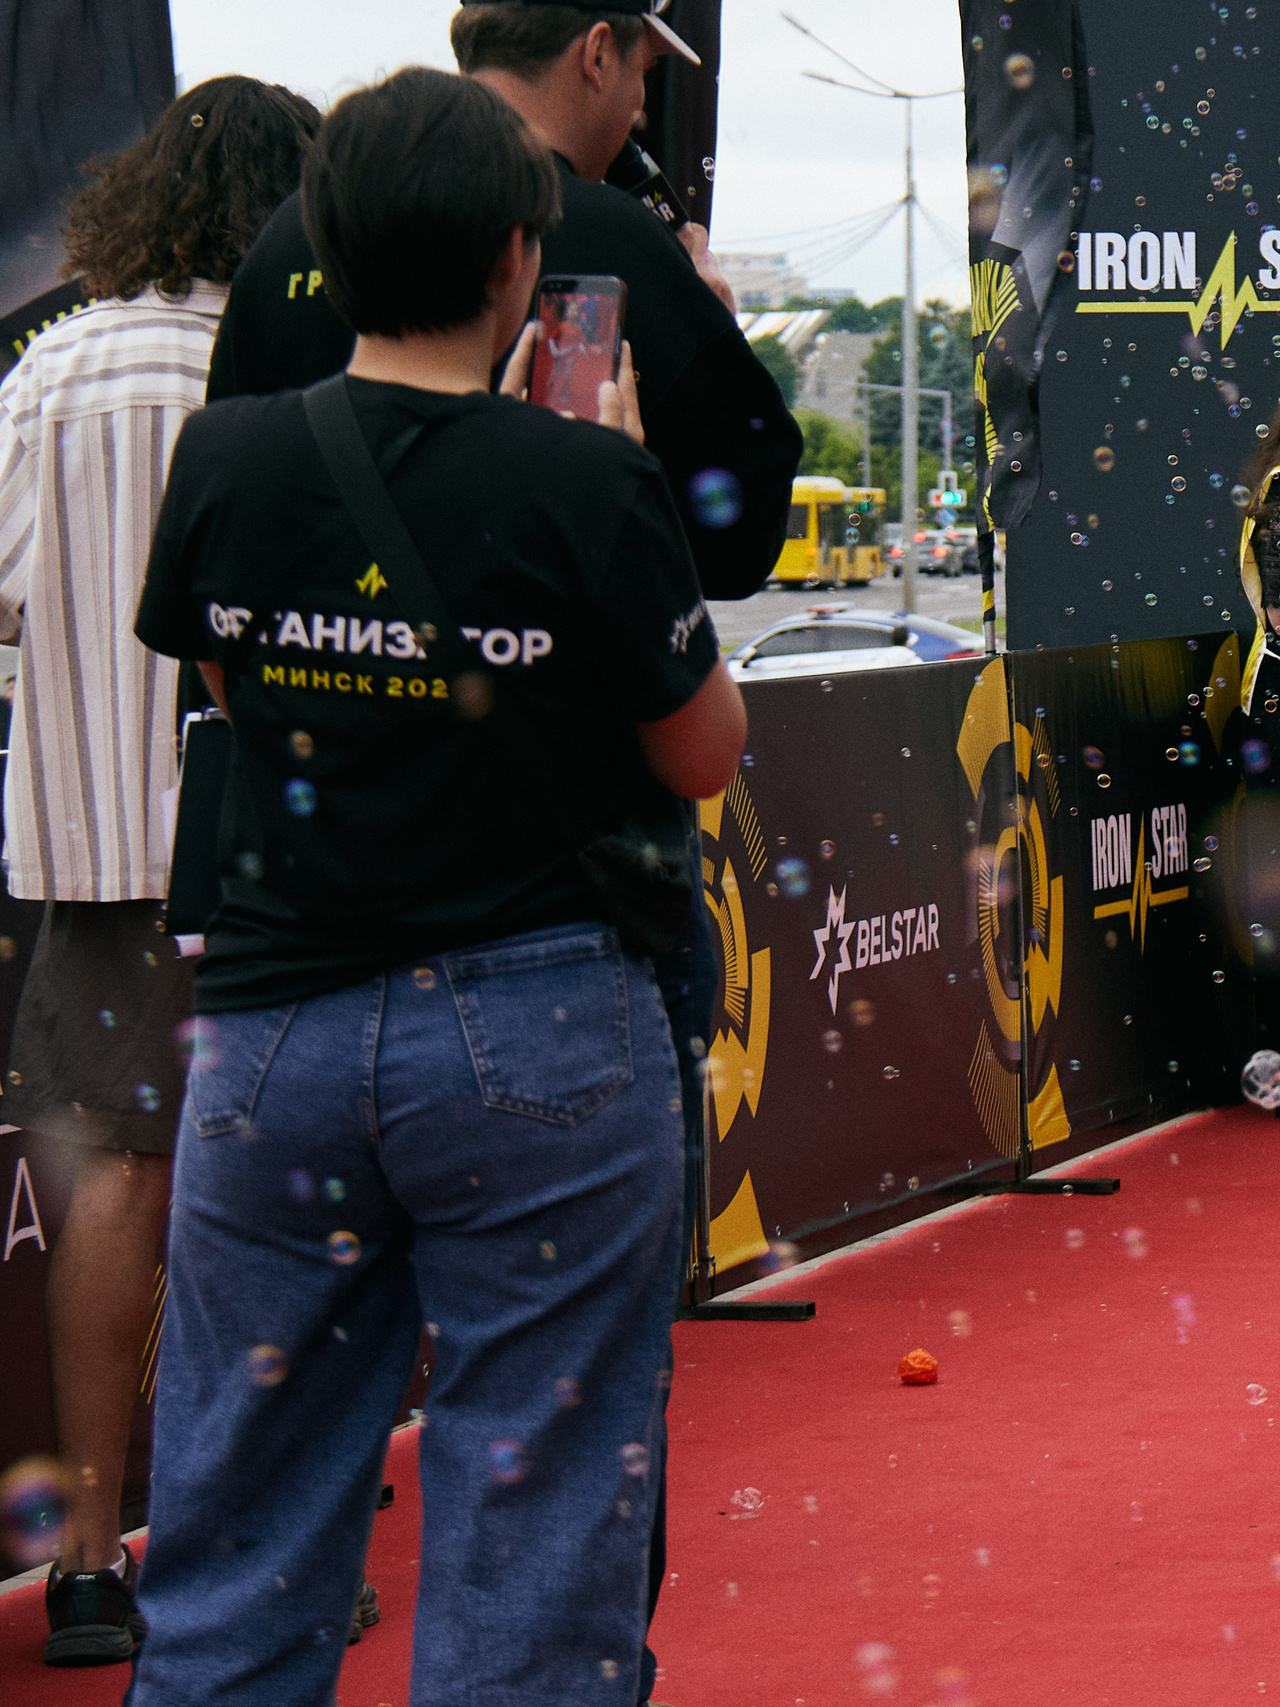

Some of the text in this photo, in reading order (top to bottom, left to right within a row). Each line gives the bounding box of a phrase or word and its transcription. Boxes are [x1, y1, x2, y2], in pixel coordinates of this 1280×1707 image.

[1078, 230, 1197, 291] IRON
[262, 663, 451, 700] МИНСК 202
[1091, 802, 1190, 892] IRON STAR
[855, 903, 941, 969] BELSTAR
